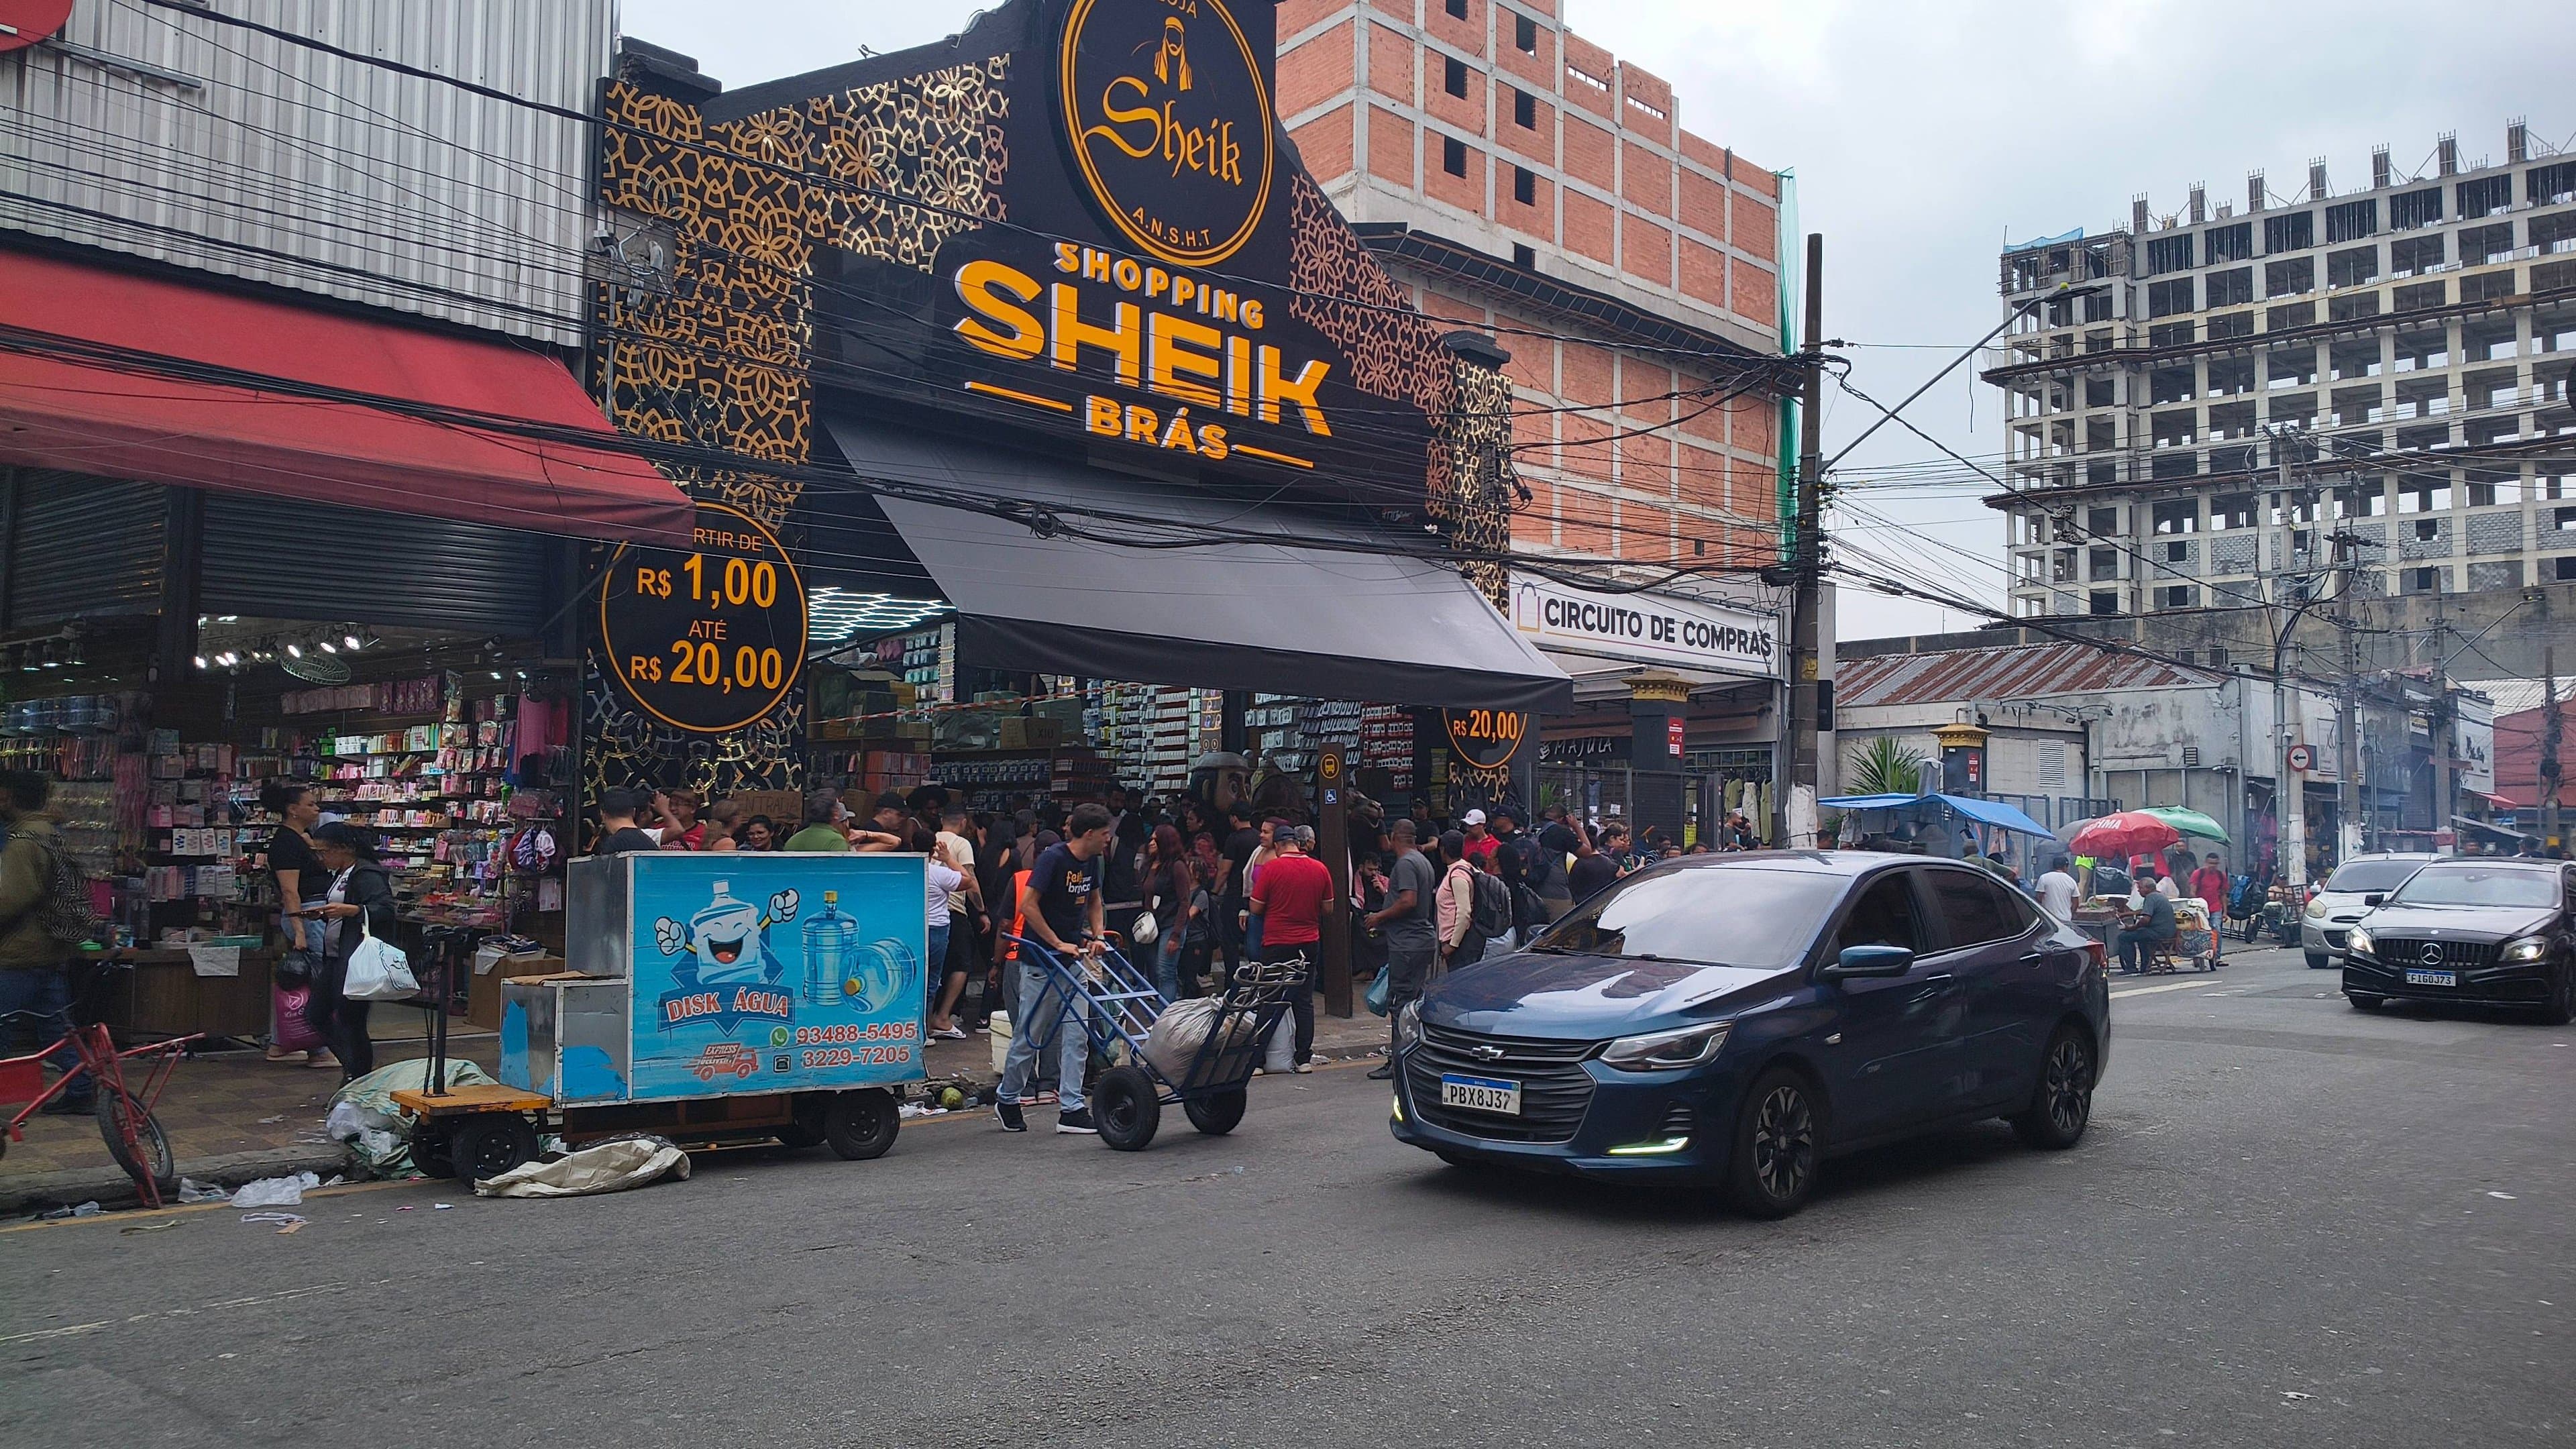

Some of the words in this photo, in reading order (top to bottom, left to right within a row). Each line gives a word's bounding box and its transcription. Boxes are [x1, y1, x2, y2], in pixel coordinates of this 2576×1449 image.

[1081, 76, 1242, 186] Sheik
[1054, 241, 1264, 329] SHOPPING
[953, 260, 1333, 437] SHEIK
[1085, 394, 1228, 460] BRÁS
[739, 534, 763, 551] DE
[637, 568, 672, 600] R$
[684, 553, 777, 610] 1,00
[688, 619, 727, 640] ATÉ
[1545, 598, 1643, 637] CIRCUITO
[1651, 614, 1675, 643] DE
[1683, 620, 1772, 657] COMPRAS
[631, 655, 662, 684] R$
[670, 639, 782, 694] 20,00
[1454, 720, 1467, 737] R$
[1470, 710, 1518, 744] 20,00
[666, 991, 721, 1022] DISK
[733, 986, 788, 1017] ÁGUA
[705, 1044, 739, 1055] EXPRESS
[796, 1022, 917, 1045] 93488-5495
[802, 1046, 910, 1069] 3229-7205
[1450, 1085, 1511, 1110] PBX8J37
